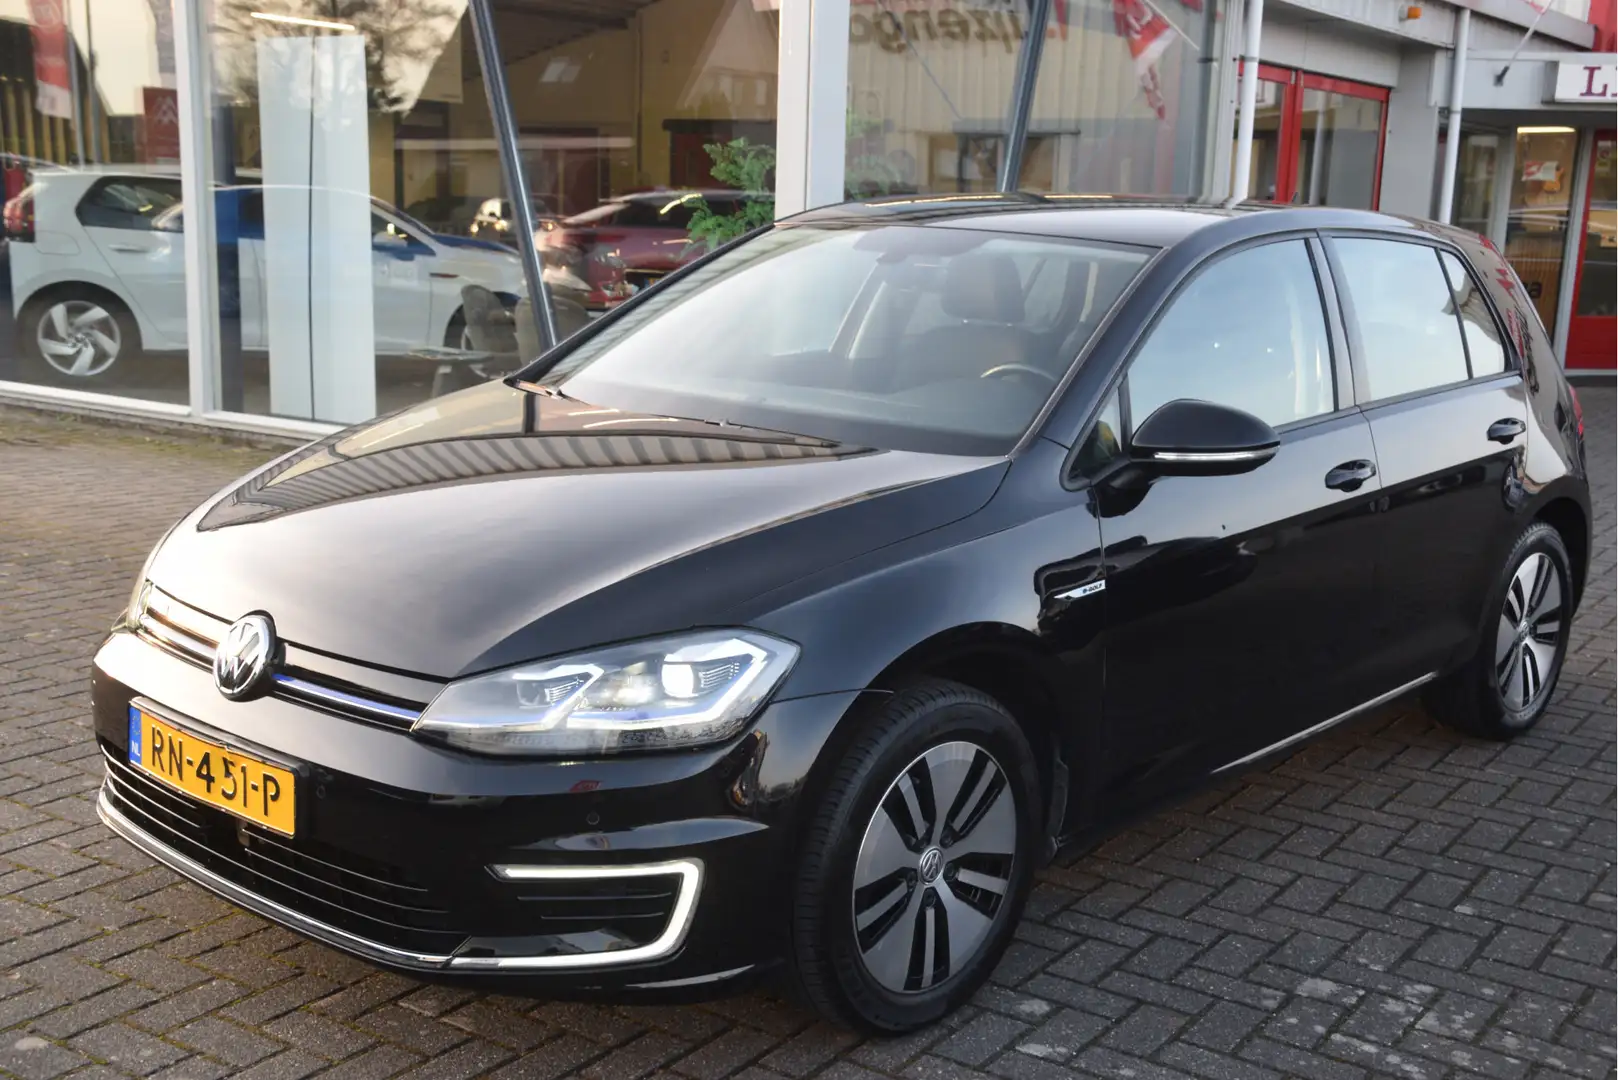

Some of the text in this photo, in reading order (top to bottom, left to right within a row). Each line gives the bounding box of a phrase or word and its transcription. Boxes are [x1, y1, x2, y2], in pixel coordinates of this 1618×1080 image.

[1579, 66, 1618, 97] L
[131, 740, 141, 757] NL
[150, 723, 281, 817] RN-451-P
